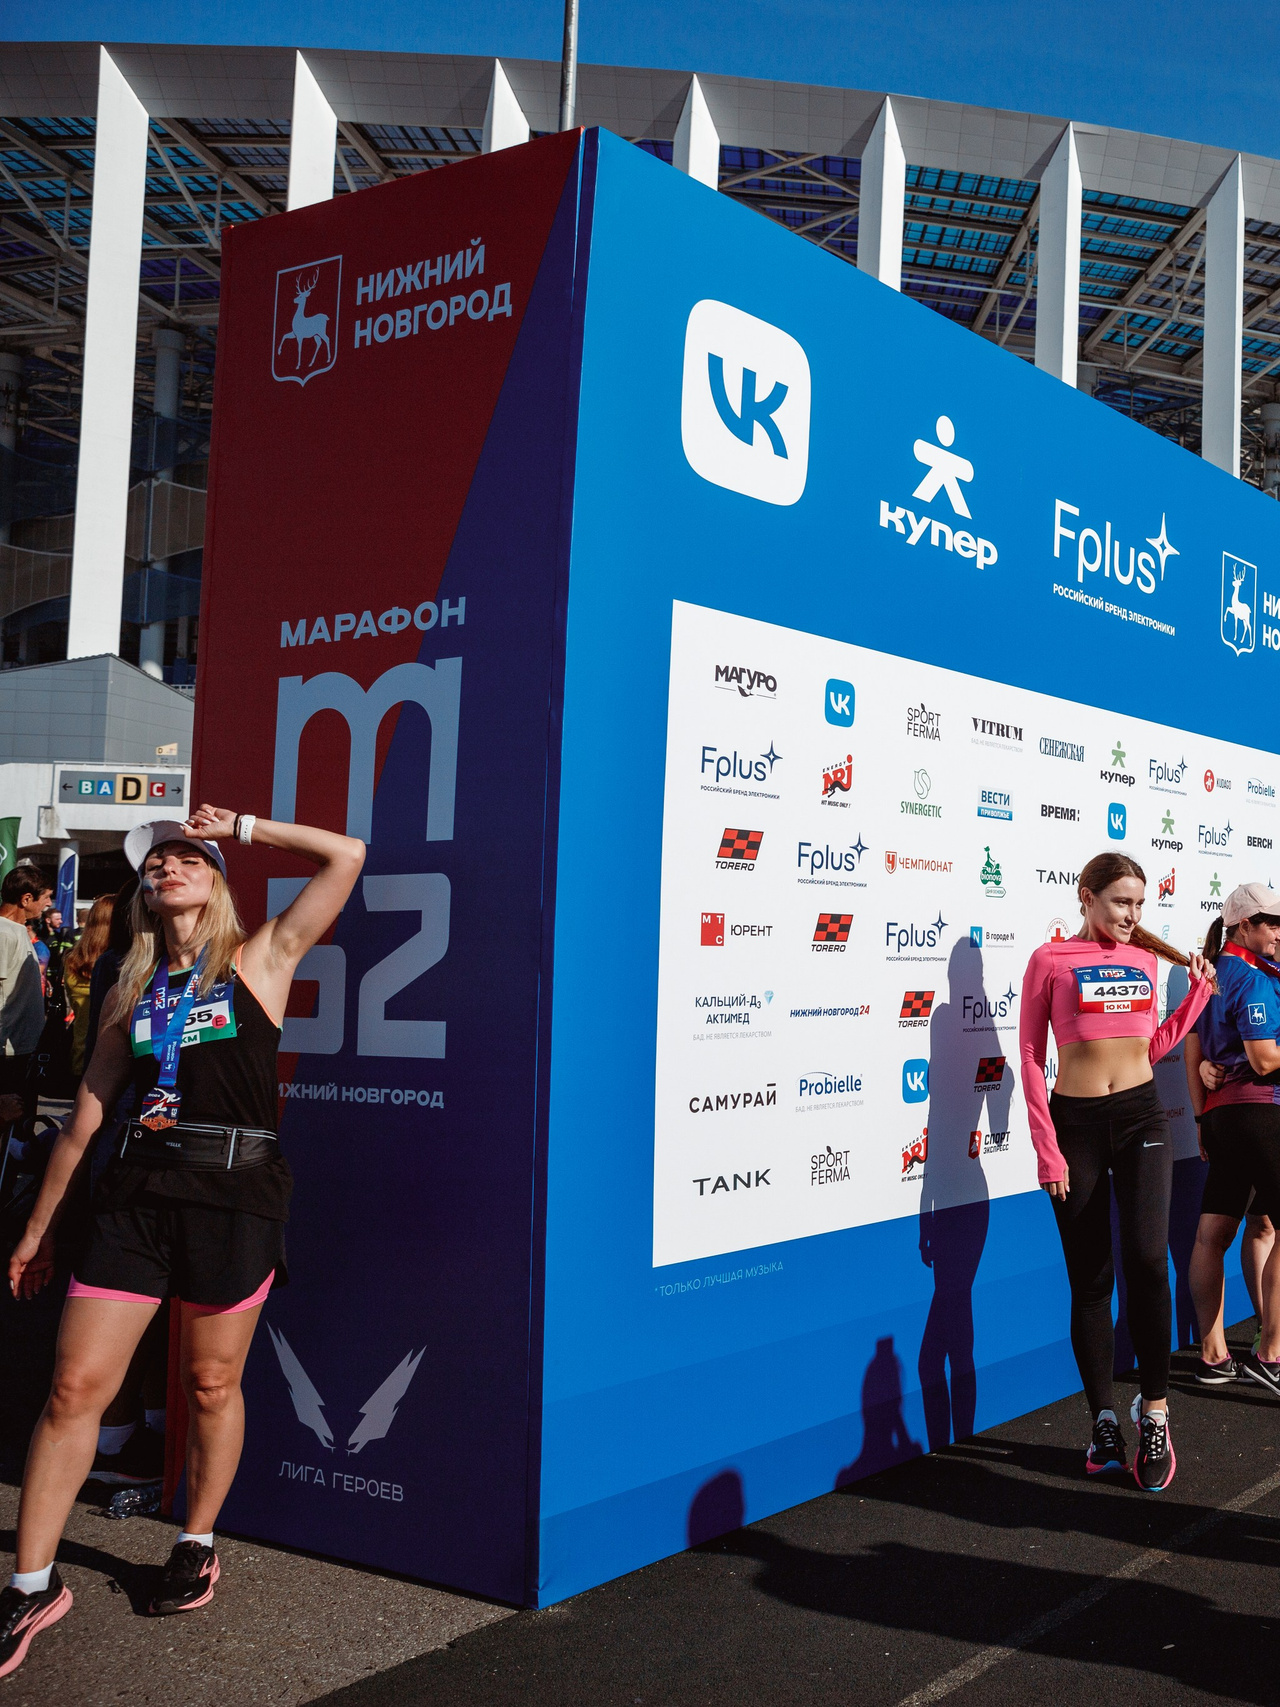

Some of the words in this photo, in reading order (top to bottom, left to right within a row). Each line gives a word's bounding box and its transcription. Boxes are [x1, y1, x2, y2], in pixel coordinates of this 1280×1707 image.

[356, 237, 487, 306] НИЖНИЙ
[354, 282, 513, 349] НОВГОРОД
[707, 351, 790, 461] VK
[879, 499, 999, 571] купер
[1053, 498, 1157, 595] Fplus
[1053, 583, 1104, 611] РОССИЙСКИЙ
[1104, 602, 1128, 621] БРЕНД
[1128, 610, 1176, 637] ЭЛЕКТРОНИКИ
[279, 596, 467, 649] МАРАФОН
[714, 664, 778, 693] МАГУРО
[829, 690, 851, 716] VK
[906, 706, 942, 727] SPORT
[906, 722, 942, 742] FERMA
[971, 716, 1024, 742] VITRUM
[1039, 736, 1085, 763] СЕНЕЖСКАЯ
[701, 745, 767, 783] Fplus
[822, 761, 847, 773] ENERGY
[1149, 758, 1181, 784] Fplus
[1100, 769, 1136, 787] купер
[81, 781, 93, 794] B
[99, 781, 112, 794] A
[121, 776, 142, 801] D
[152, 783, 163, 796] C
[700, 784, 733, 794] РОССИЙСКИЙ
[733, 788, 748, 797] БРЕНД
[748, 790, 780, 800] ЭЛЕКТРОНИКИ
[981, 789, 1011, 806] ВЕСТИ
[1247, 780, 1276, 798] Probielle
[900, 800, 942, 818] SYNERGETIC
[980, 808, 1010, 820] ПРИВОЛЖЬЕ
[1110, 812, 1124, 832] VK
[1151, 838, 1184, 853] купер
[1198, 824, 1227, 849] Fplus
[1246, 835, 1273, 850] BERCH
[715, 860, 755, 872] TORERO
[797, 841, 856, 876] Fplus
[899, 856, 954, 873] ЧЕМПИОНАТ
[797, 878, 826, 886] РОССИЙСКИЙ
[839, 880, 868, 888] ЭЛЕКТРОНИКИ
[1036, 869, 1081, 886] TANK
[1200, 901, 1224, 912] купе
[730, 924, 773, 937] ЮРЕНТ
[886, 921, 937, 953] Fplus
[991, 932, 1009, 943] городе
[811, 943, 847, 953] TORERO
[1094, 985, 1139, 997] 4437
[706, 1012, 750, 1025] АКТИМЕД
[790, 1006, 822, 1018] НИЖНИЙ
[962, 995, 1008, 1024] Fplus
[898, 1019, 929, 1028] TORERO
[799, 1074, 862, 1097] Probielle
[906, 1070, 926, 1092] VK
[973, 1083, 1001, 1093] TORERO
[278, 1082, 338, 1100] ИЖНИЙ
[341, 1086, 445, 1109] НОВГОРОД
[689, 1083, 777, 1113] САМУРАЙ
[984, 1131, 1011, 1146] СПОРТ
[983, 1143, 1010, 1155] ЭКСПРЕСС
[810, 1150, 851, 1170] SPORT
[692, 1168, 771, 1196] TANK
[810, 1166, 851, 1186] FERMA
[660, 1278, 701, 1296] ТОЛЬКО
[703, 1269, 743, 1288] ЛУЧШАЯ
[745, 1261, 784, 1278] МУЗЫКА
[278, 1460, 326, 1487] ЛИГА
[332, 1472, 404, 1502] ГЕРОЕВ
